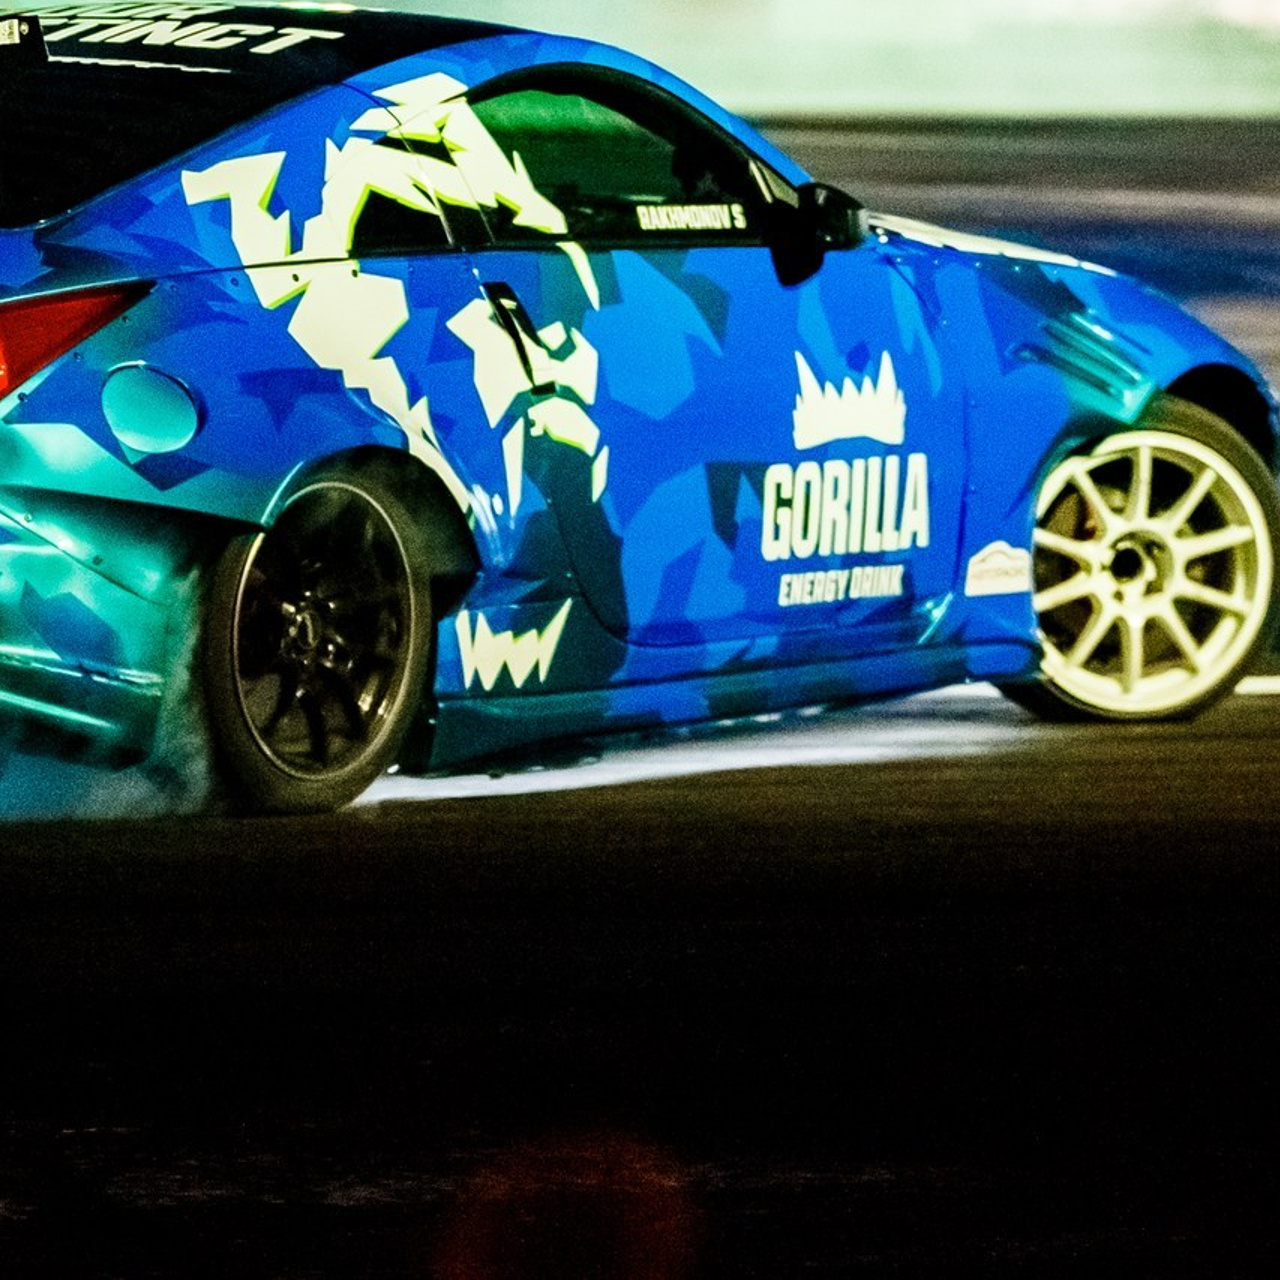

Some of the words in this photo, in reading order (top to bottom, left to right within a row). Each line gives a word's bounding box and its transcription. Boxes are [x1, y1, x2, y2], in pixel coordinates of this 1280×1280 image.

[731, 203, 747, 229] S
[761, 452, 930, 562] GORILLA
[778, 569, 850, 607] ENERGY
[849, 564, 904, 599] DRINK
